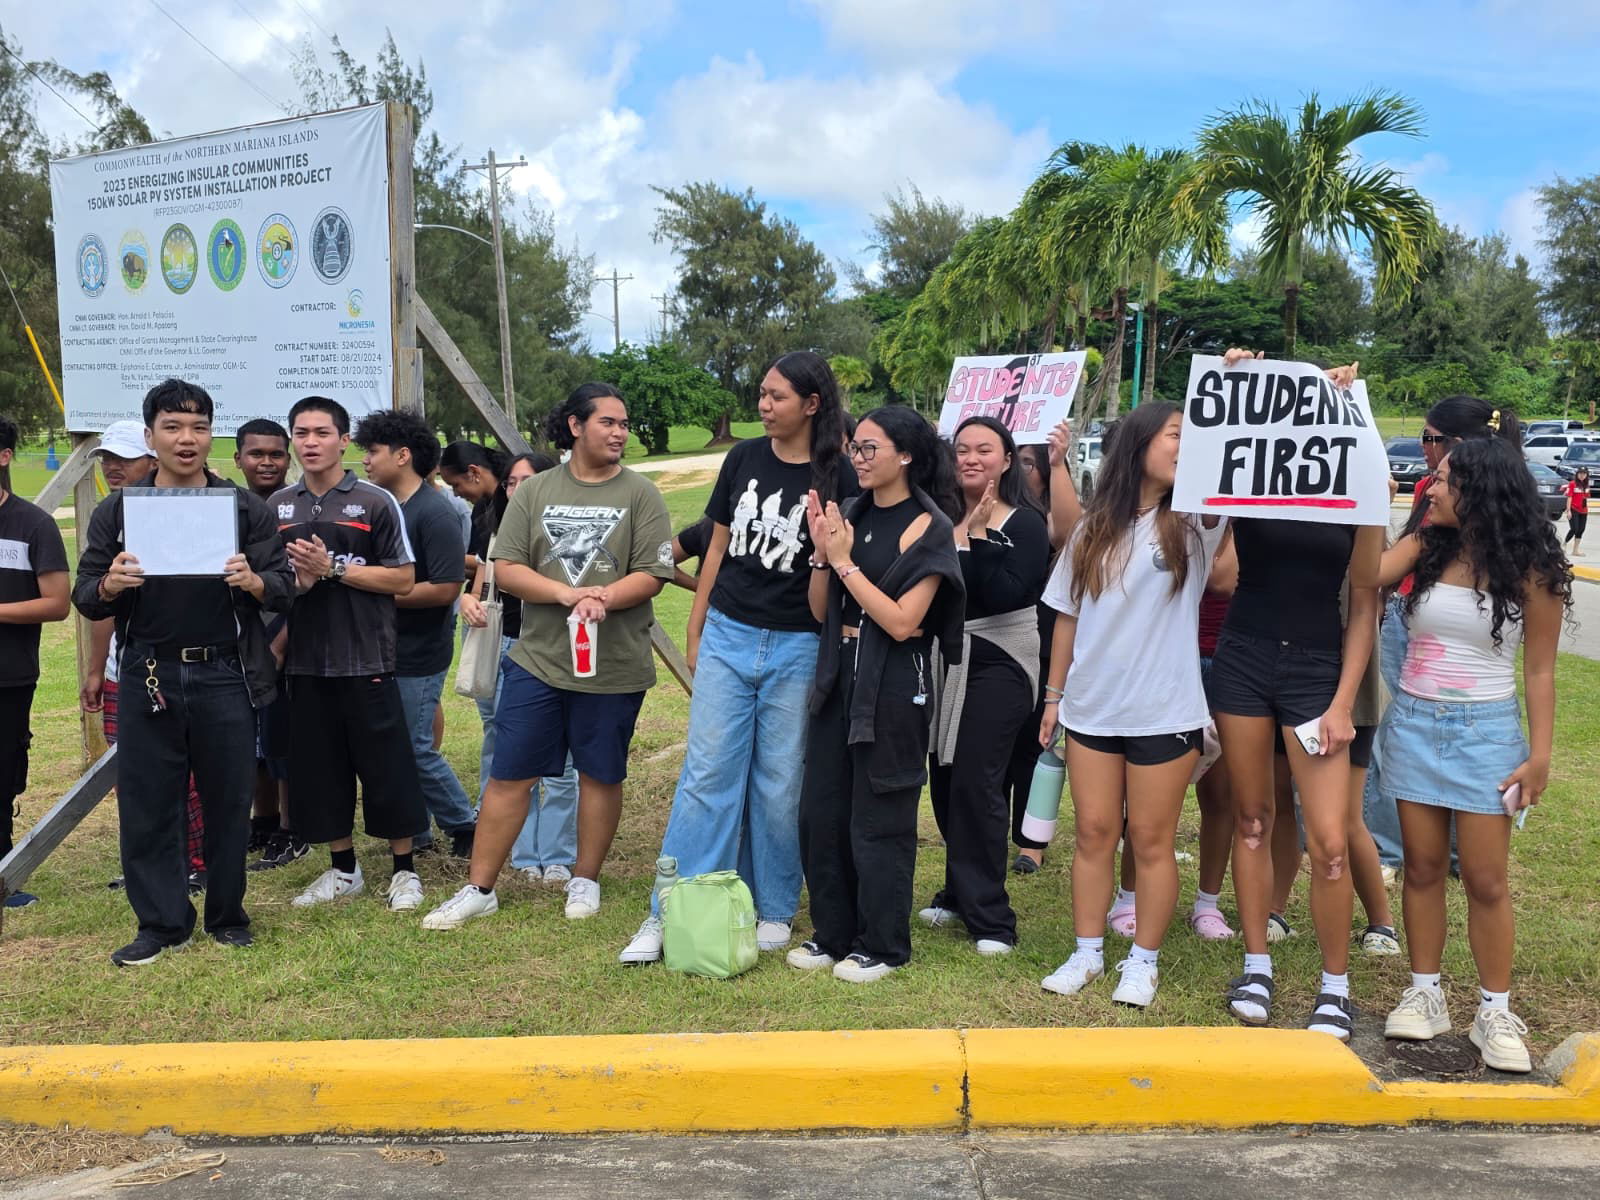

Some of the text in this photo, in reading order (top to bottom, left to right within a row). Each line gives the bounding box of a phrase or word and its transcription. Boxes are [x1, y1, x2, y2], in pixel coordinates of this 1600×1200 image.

[94, 129, 319, 172] COMMONWEALTH of the NORTHERN MARIANA ISLANDS
[103, 153, 309, 193] 2023 ENERGIZING INSULAR COMMUNITIES
[88, 167, 332, 211] 150kW SOLAR PV SYSTEM INSTALLATION PROJECT
[290, 302, 337, 313] CONTRACTOR:
[339, 321, 375, 329] MICRONESIA
[274, 342, 307, 352] CONTRACT
[309, 341, 339, 350] NUMBER:
[299, 354, 319, 364] START
[320, 353, 339, 363] DATE:
[278, 365, 383, 376] COMPLETION DATE: 01/20/2025
[275, 380, 308, 390] CONTRACT
[310, 379, 340, 389] AMOUNT:
[946, 361, 1078, 403] STUDENTS
[1218, 435, 1357, 496] FIRST
[277, 504, 295, 519] 89
[542, 504, 628, 520] HAGGAN
